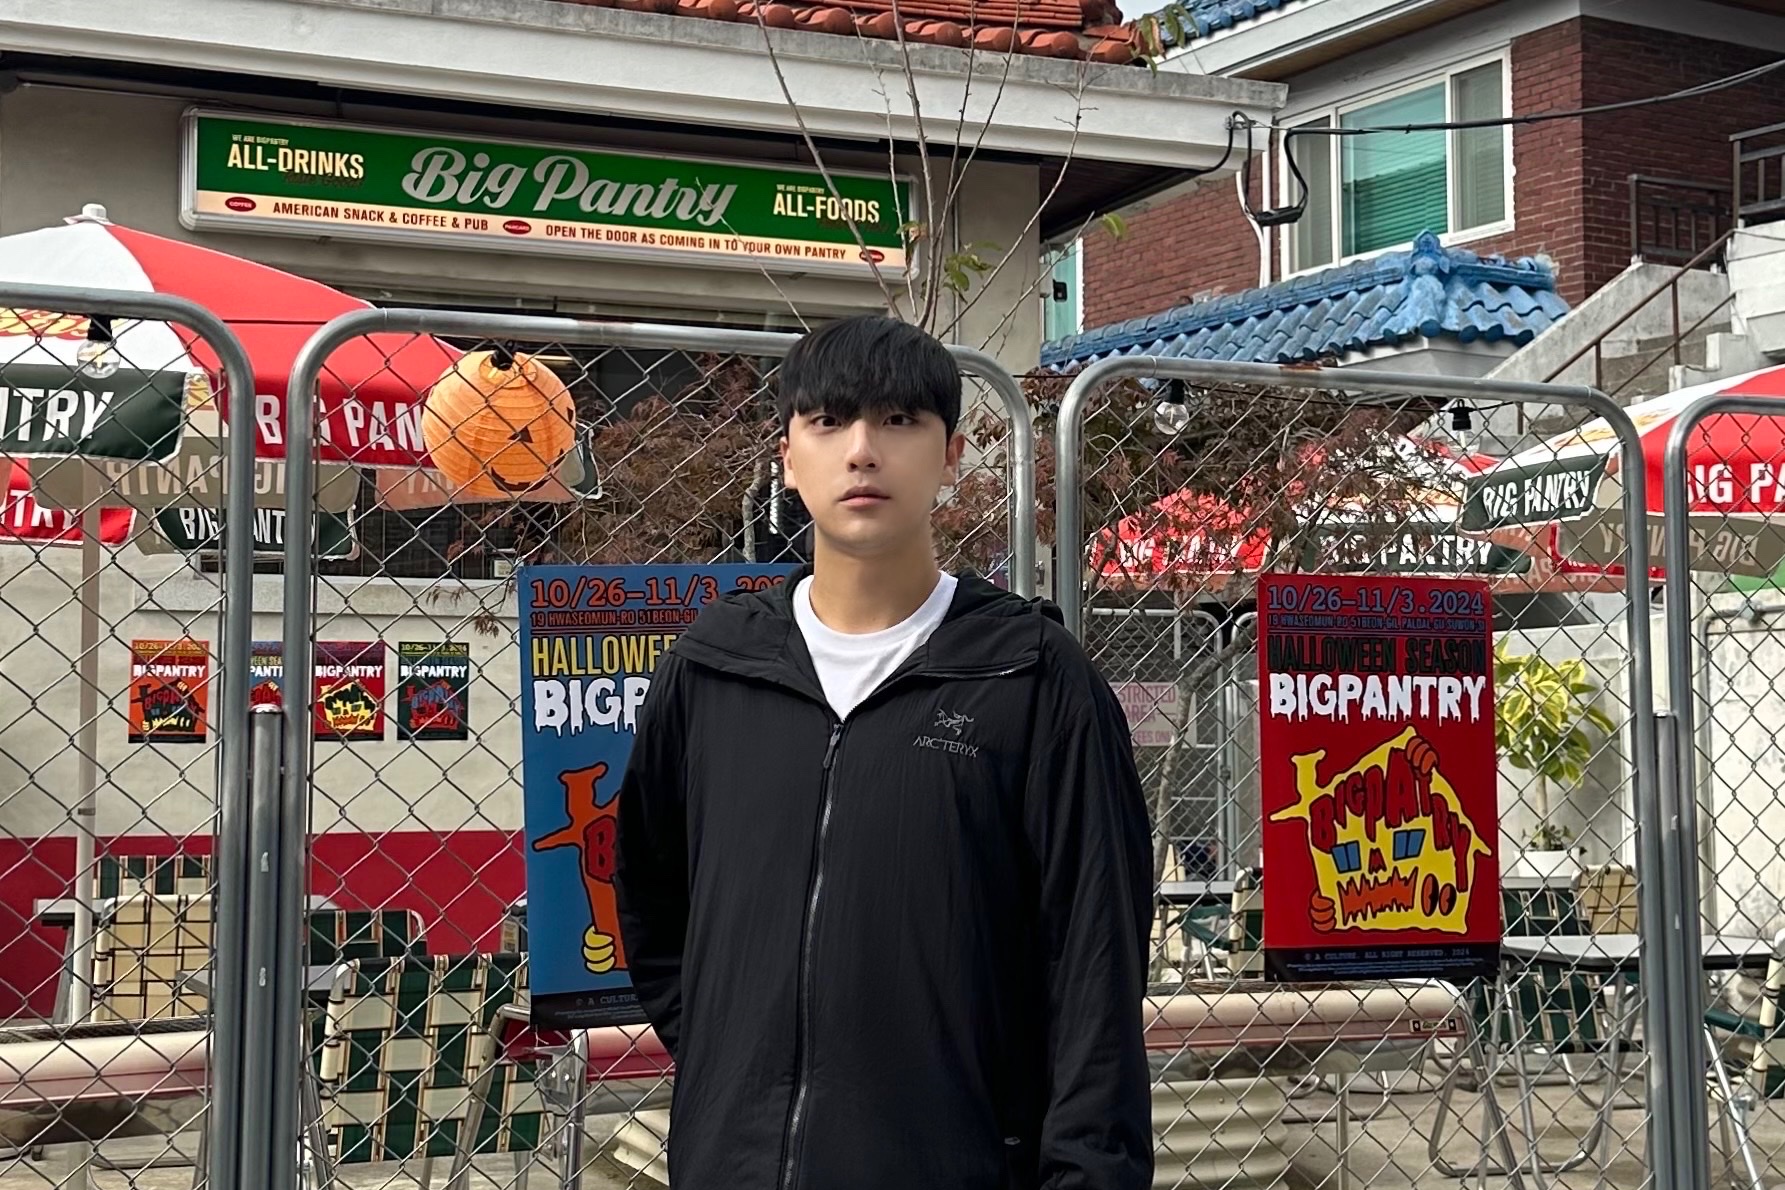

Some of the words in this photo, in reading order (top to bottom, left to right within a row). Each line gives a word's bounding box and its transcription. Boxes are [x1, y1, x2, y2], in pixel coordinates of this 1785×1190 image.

[227, 143, 364, 179] ALL-DRINKS
[401, 146, 529, 209] Big
[533, 155, 739, 226] Pantry
[273, 202, 339, 219] AMERICAN
[343, 208, 385, 222] SNACK
[388, 212, 398, 223] &
[402, 212, 447, 227] COFFEE
[451, 217, 460, 229] &
[464, 218, 489, 231] PUB
[773, 192, 880, 223] ALL-FOODS
[546, 224, 577, 238] OPEN
[580, 227, 602, 240] THE
[606, 229, 637, 243] DOOR
[641, 233, 656, 244] AS
[659, 234, 705, 248] COMING
[709, 238, 721, 250] IN
[725, 238, 738, 251] TO
[743, 241, 771, 253] YOUR
[775, 244, 801, 256] OWN
[804, 246, 846, 260] PANTRY
[0, 387, 114, 441] TRY
[343, 398, 425, 452] PAN
[1267, 584, 1485, 615] 10/26-11/3.2024
[530, 611, 545, 627] 19
[133, 664, 206, 678] BIGPANTRY
[1267, 635, 1396, 673] HALLOWEEN
[1406, 638, 1486, 674] SEASON
[315, 665, 383, 678] BIGPANTRY
[400, 665, 468, 678] BIGPANTRY
[1269, 672, 1487, 727] BIGPANTRY
